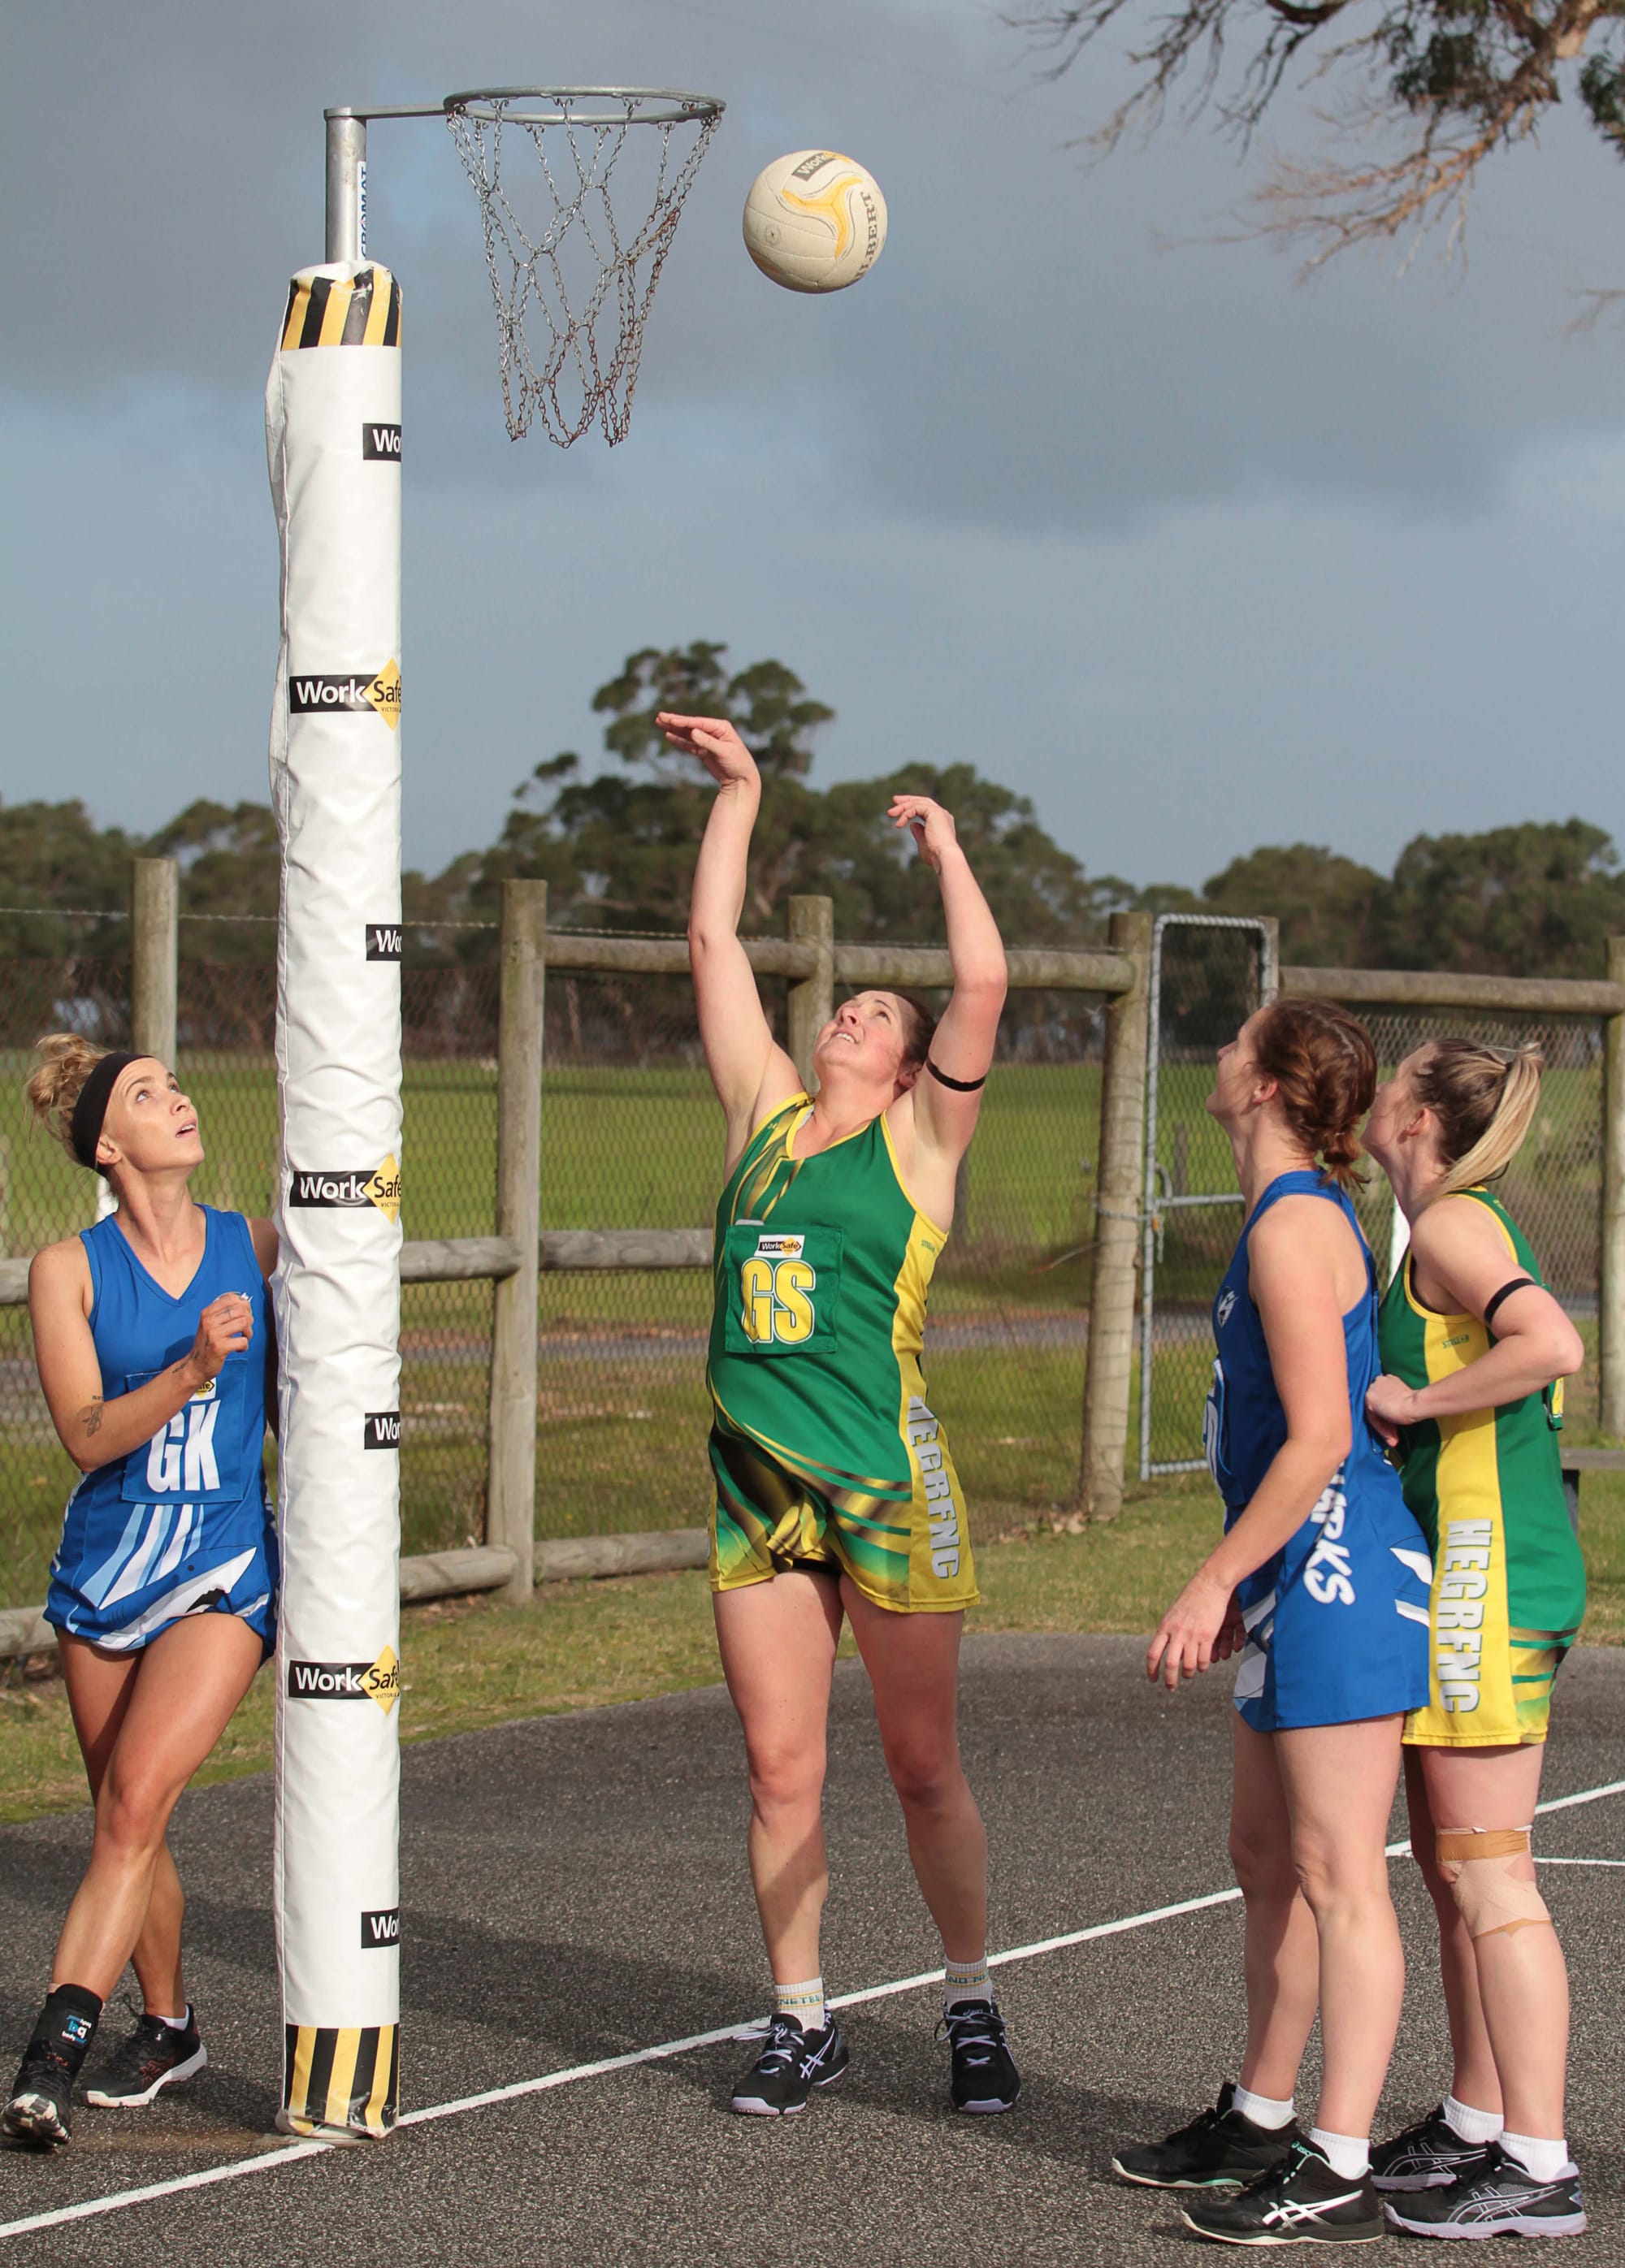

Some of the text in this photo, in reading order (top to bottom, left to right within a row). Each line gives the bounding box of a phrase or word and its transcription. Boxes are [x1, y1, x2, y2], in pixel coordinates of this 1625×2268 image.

[854, 192, 878, 279] ILBERT
[372, 429, 401, 453] Wo
[741, 1257, 817, 1344] GS
[146, 1399, 221, 1493] GK
[375, 1417, 401, 1440] Wor
[1303, 1459, 1355, 1605] ARKS
